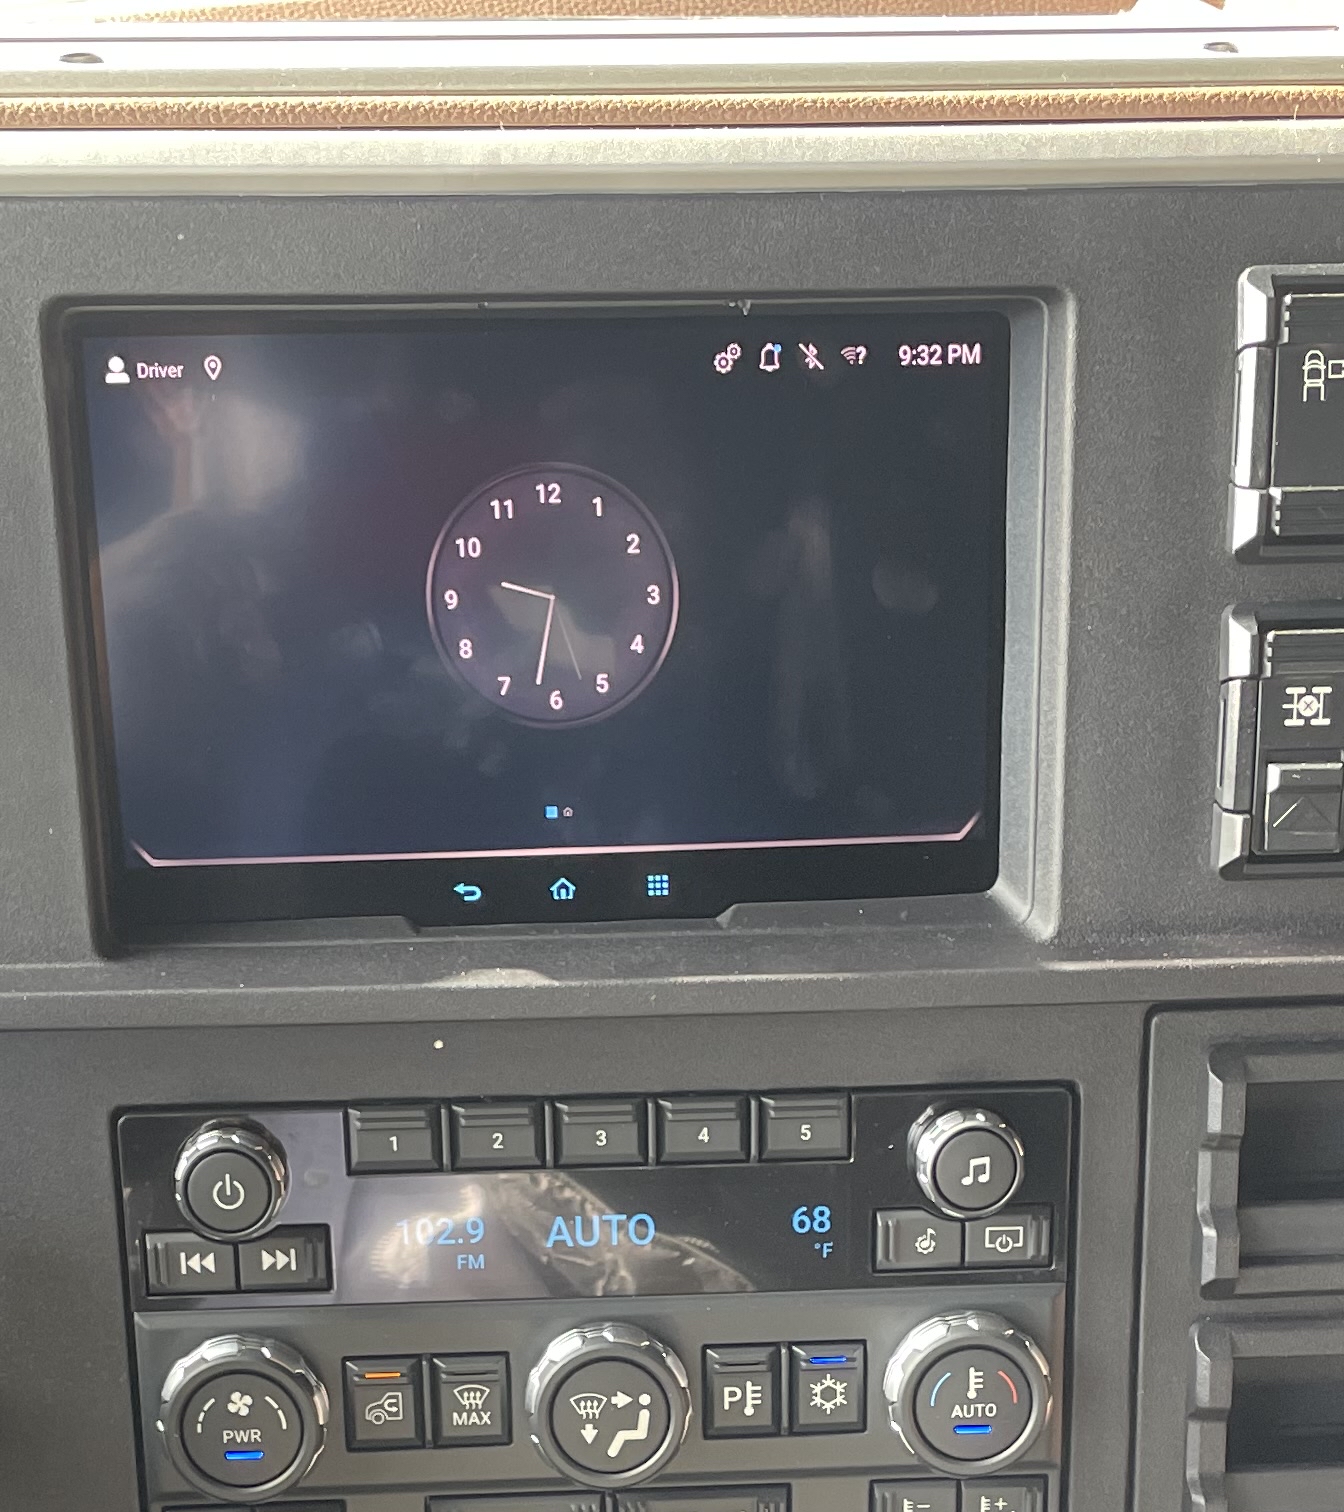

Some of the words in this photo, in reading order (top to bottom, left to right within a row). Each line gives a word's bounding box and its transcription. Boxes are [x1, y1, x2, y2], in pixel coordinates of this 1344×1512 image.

[898, 344, 944, 366] 9:32
[947, 342, 982, 366] PM
[136, 362, 185, 379] Driver
[535, 482, 562, 504] 12
[490, 498, 514, 520] 11
[592, 496, 603, 517] 1
[455, 536, 482, 558] 10
[626, 533, 641, 554] 2
[444, 589, 458, 610] 9
[646, 584, 661, 605] 3
[459, 638, 473, 659] 8
[629, 634, 645, 654] 4
[497, 676, 512, 696] 7
[596, 673, 610, 693] 5
[549, 690, 563, 710] 6
[492, 1132, 504, 1149] 2
[595, 1129, 607, 1146] 3
[697, 1127, 710, 1143] 4
[800, 1124, 812, 1141] 5
[389, 1135, 399, 1152] 1
[791, 1205, 832, 1235] 68
[397, 1216, 485, 1246] 102.9
[546, 1213, 655, 1248] AUTO
[813, 1241, 834, 1259] °F
[456, 1253, 486, 1271] FM
[451, 1406, 492, 1427] MAX
[950, 1402, 998, 1420] AUTO
[222, 1428, 262, 1445] PWR
